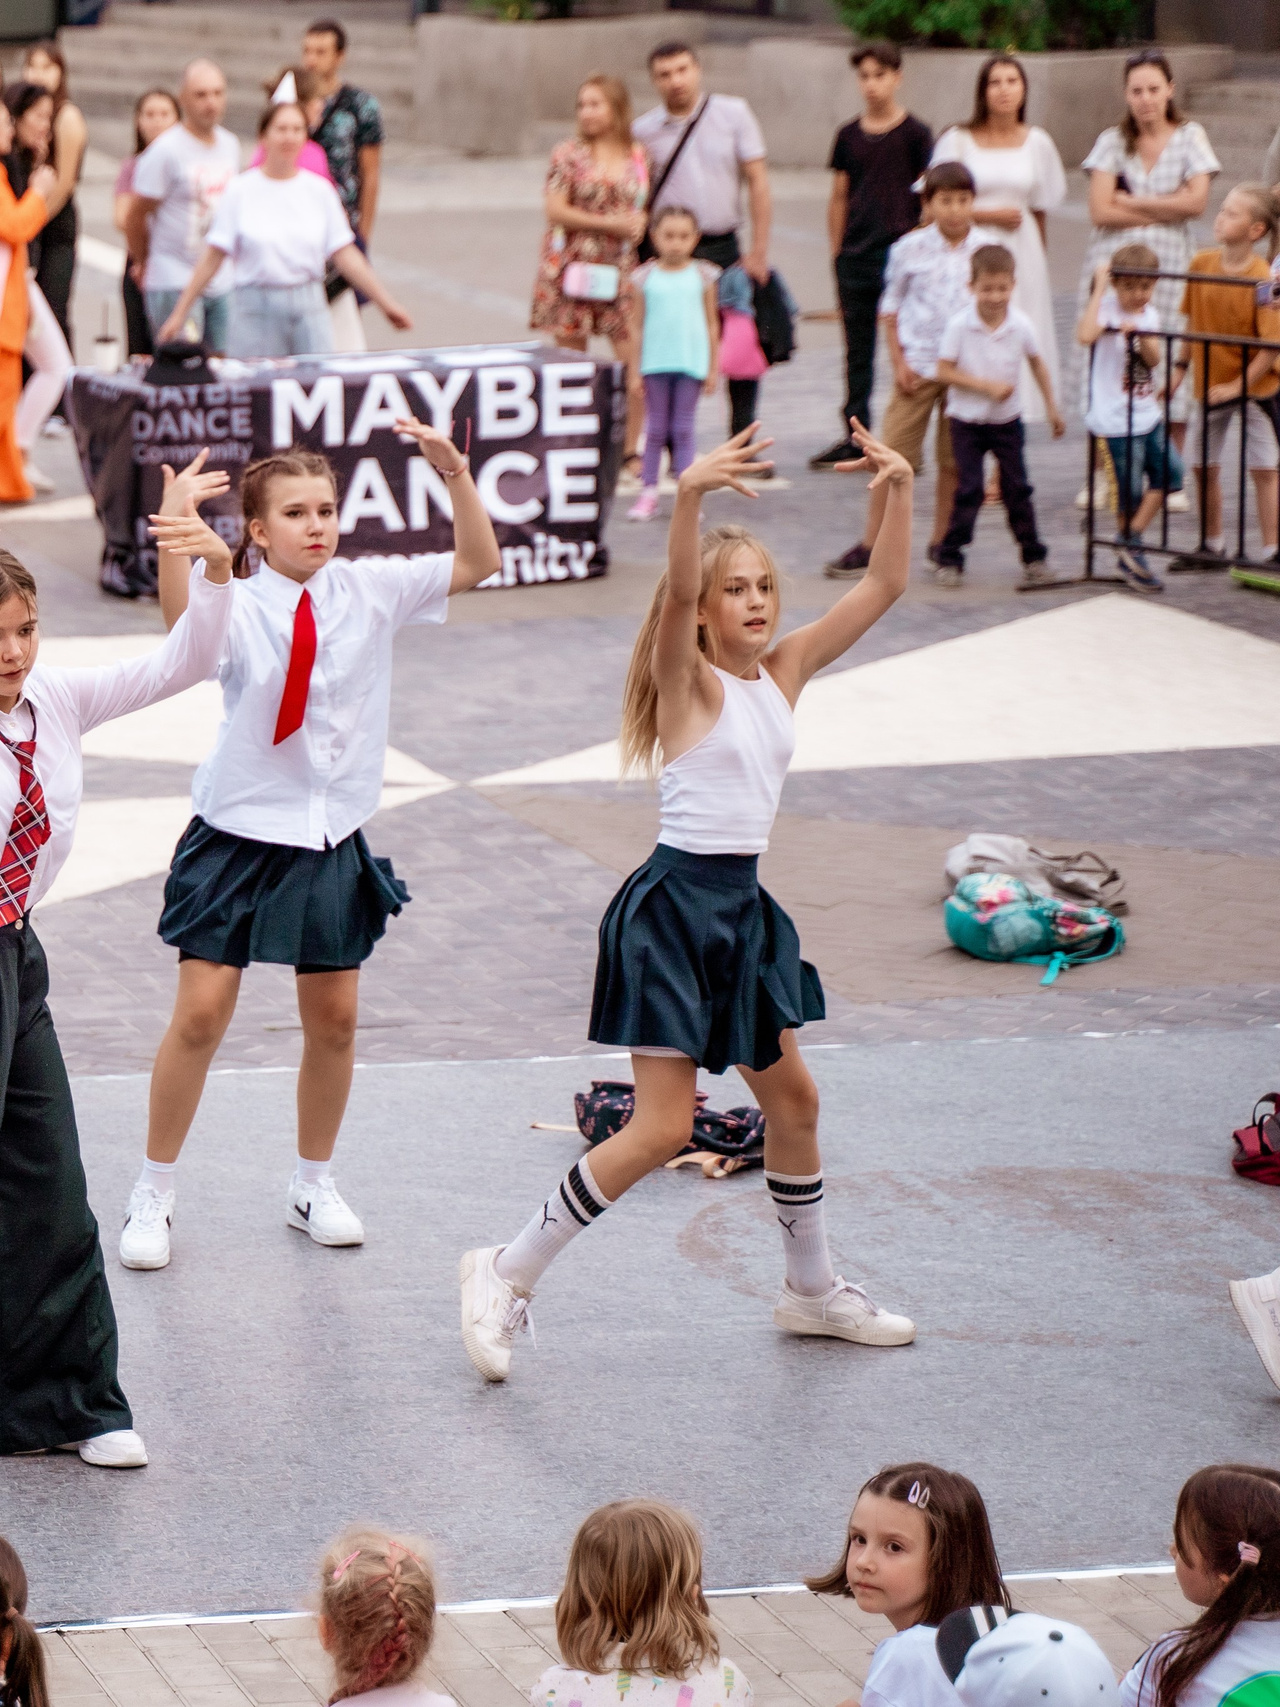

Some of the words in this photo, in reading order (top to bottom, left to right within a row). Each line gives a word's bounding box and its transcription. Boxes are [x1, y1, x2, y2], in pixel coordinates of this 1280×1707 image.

[131, 407, 254, 441] DANCE
[271, 361, 601, 449] MAYBE
[338, 448, 601, 535] ANCE
